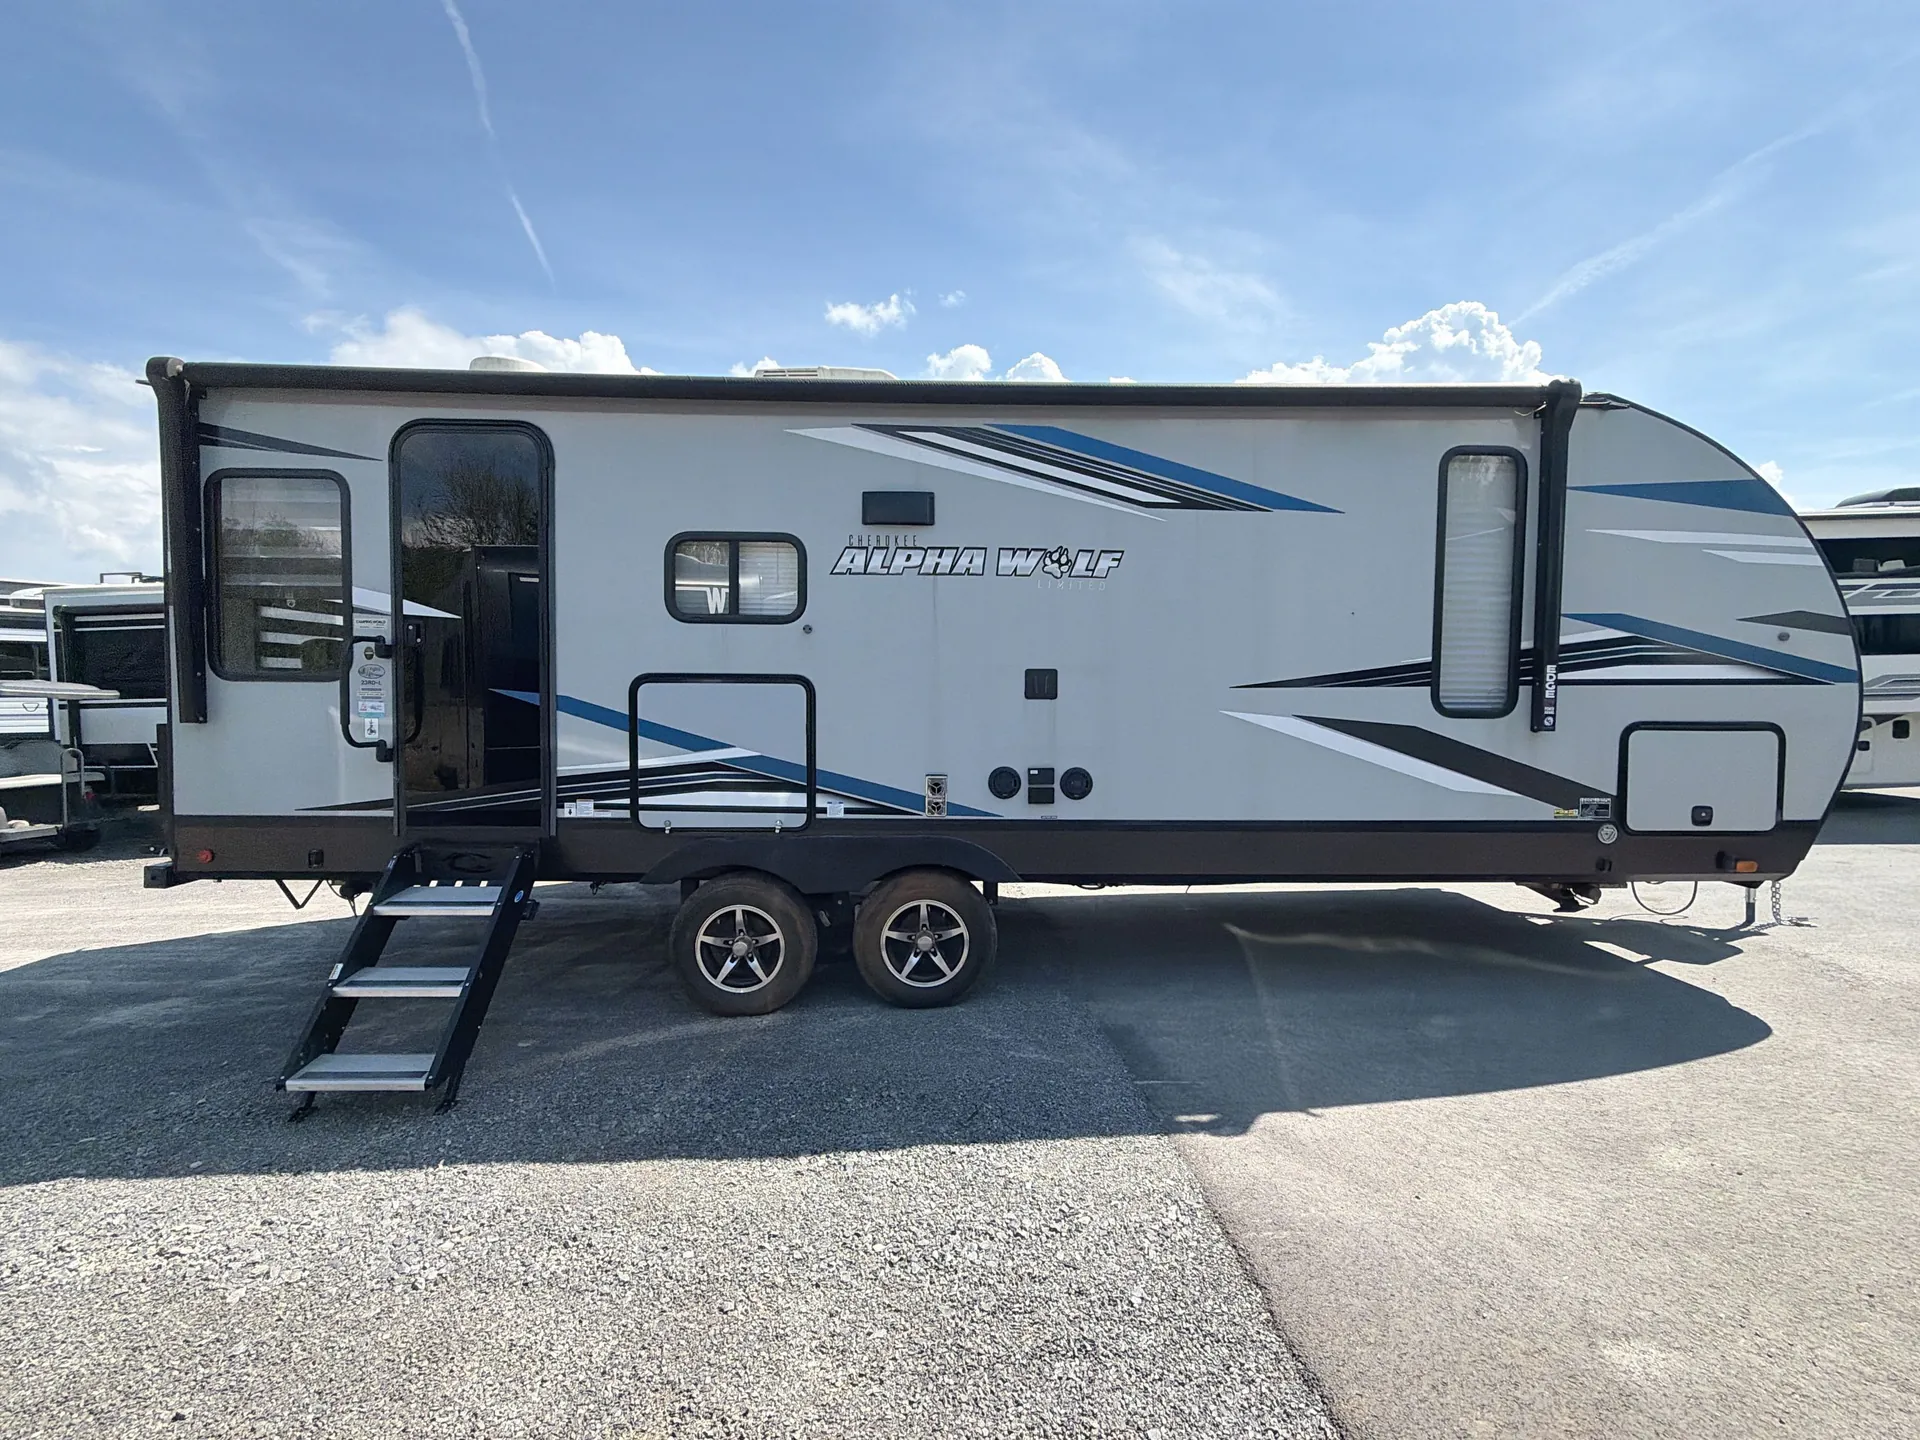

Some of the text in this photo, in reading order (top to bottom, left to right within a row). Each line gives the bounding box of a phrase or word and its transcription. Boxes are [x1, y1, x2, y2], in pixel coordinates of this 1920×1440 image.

[848, 535, 917, 547] CHEROKEE
[830, 546, 988, 576] ALPHA
[1037, 580, 1107, 591] LIMITED
[1545, 665, 1557, 698] EDGE
